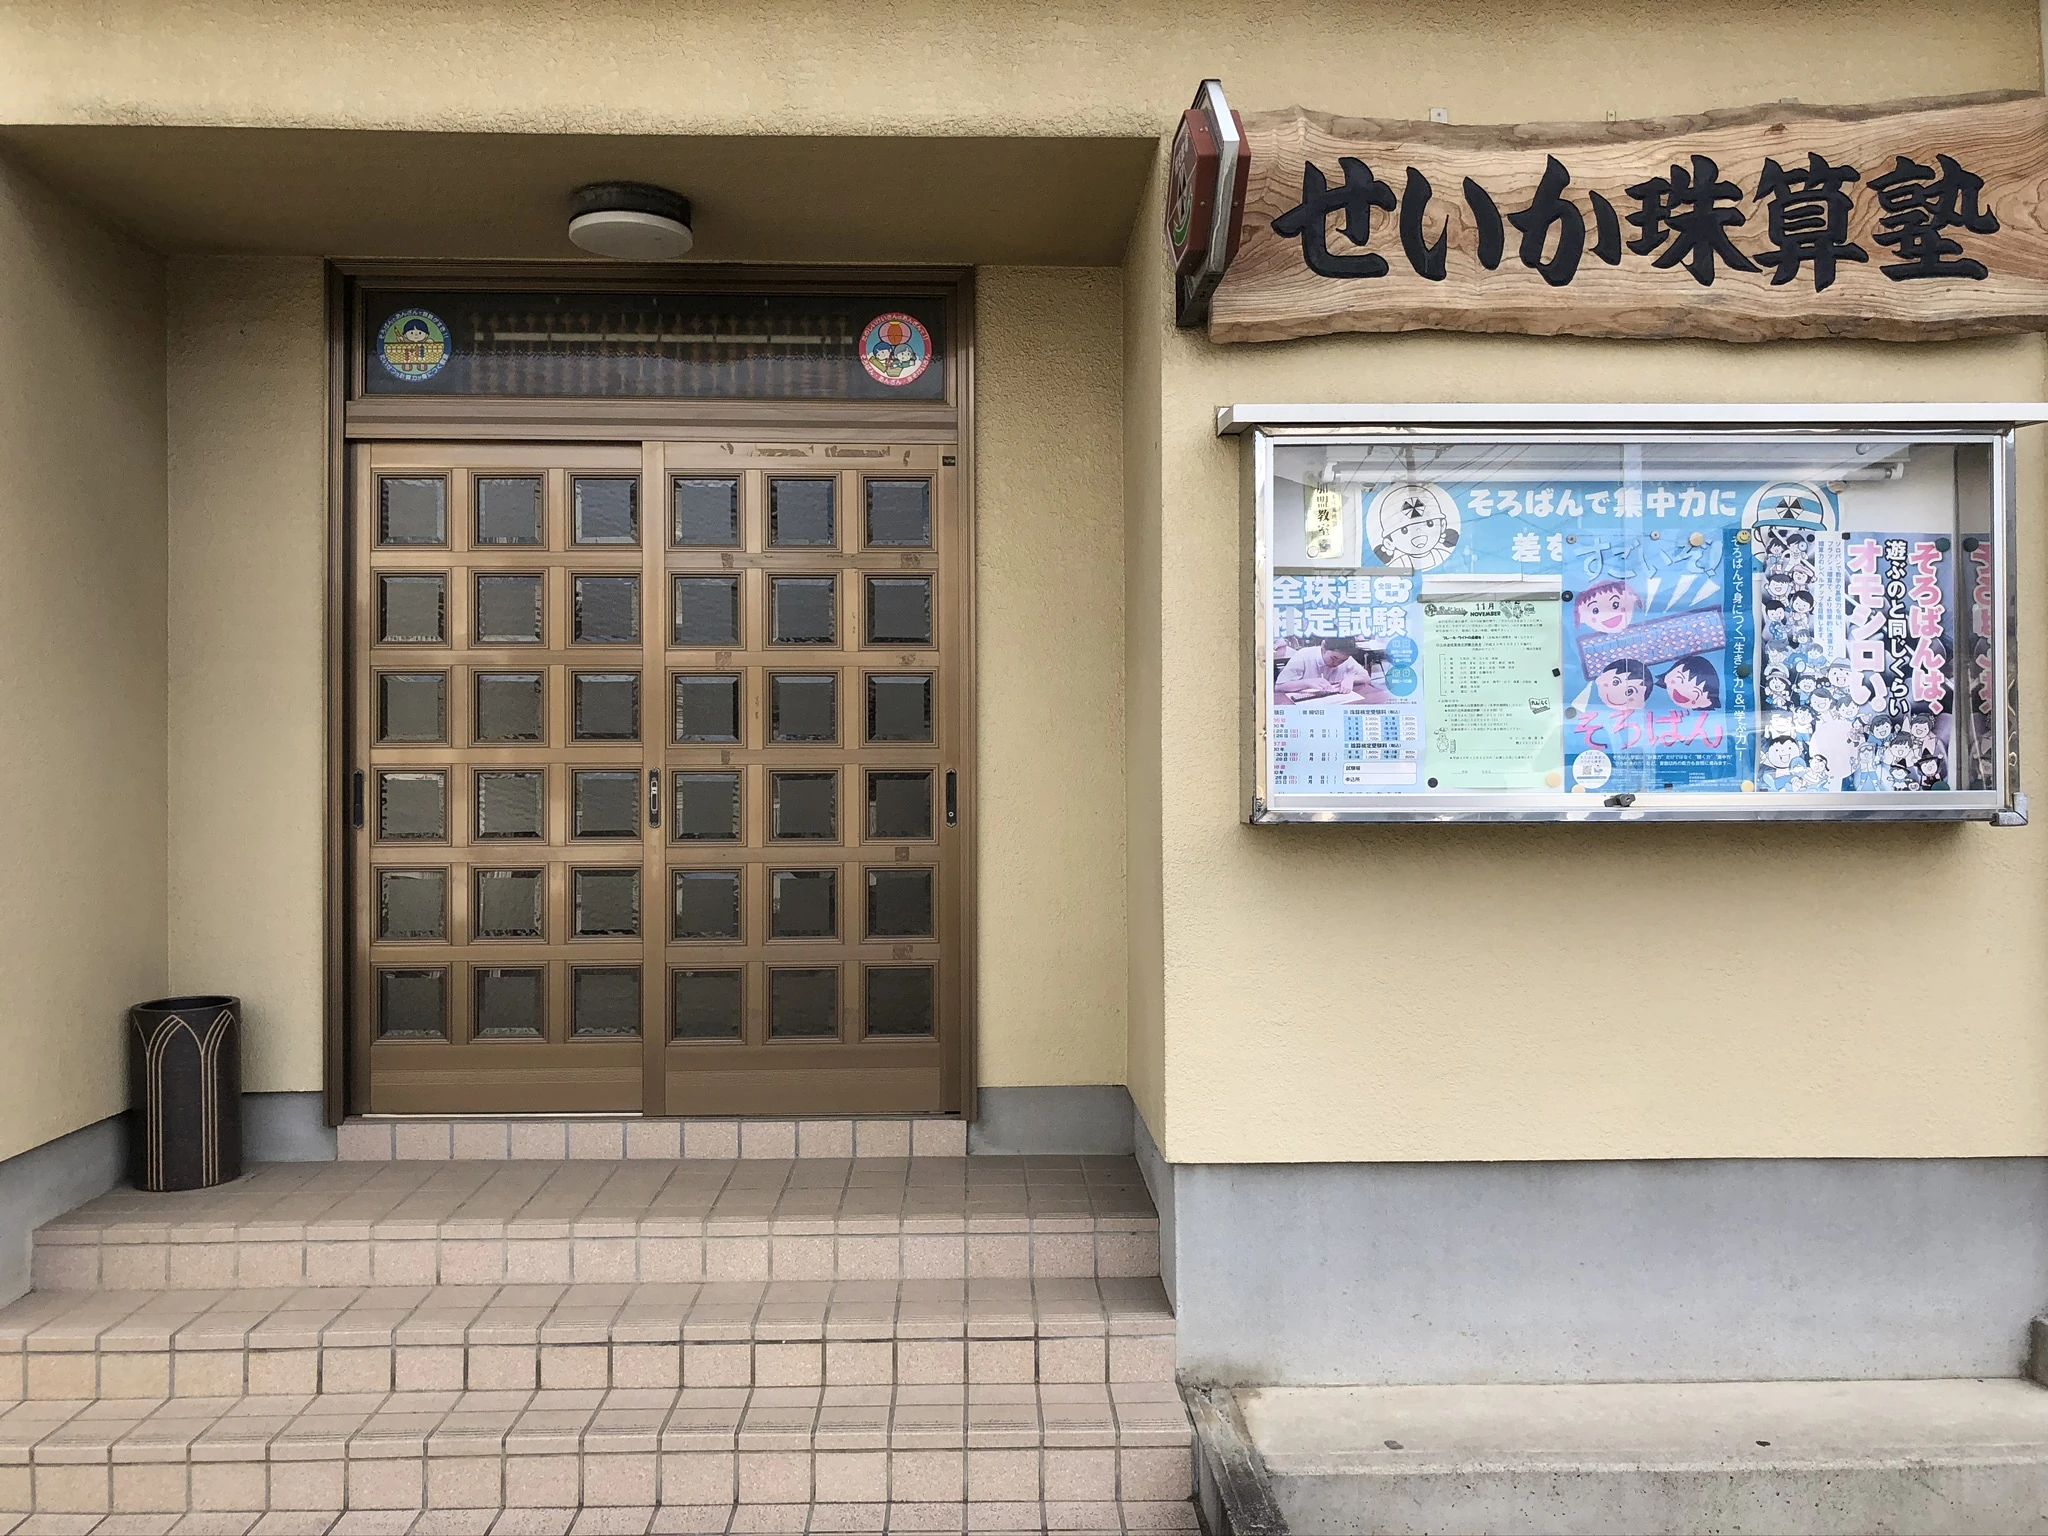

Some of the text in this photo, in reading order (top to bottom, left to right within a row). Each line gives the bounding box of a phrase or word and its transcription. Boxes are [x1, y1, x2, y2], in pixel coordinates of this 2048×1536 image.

[1272, 152, 1999, 293] せいか珠算塾
[1467, 487, 1737, 518] そろばんで集中力に
[1885, 539, 1910, 717] 遊ぶのと同じくらい
[1574, 708, 1723, 750] そろばん
